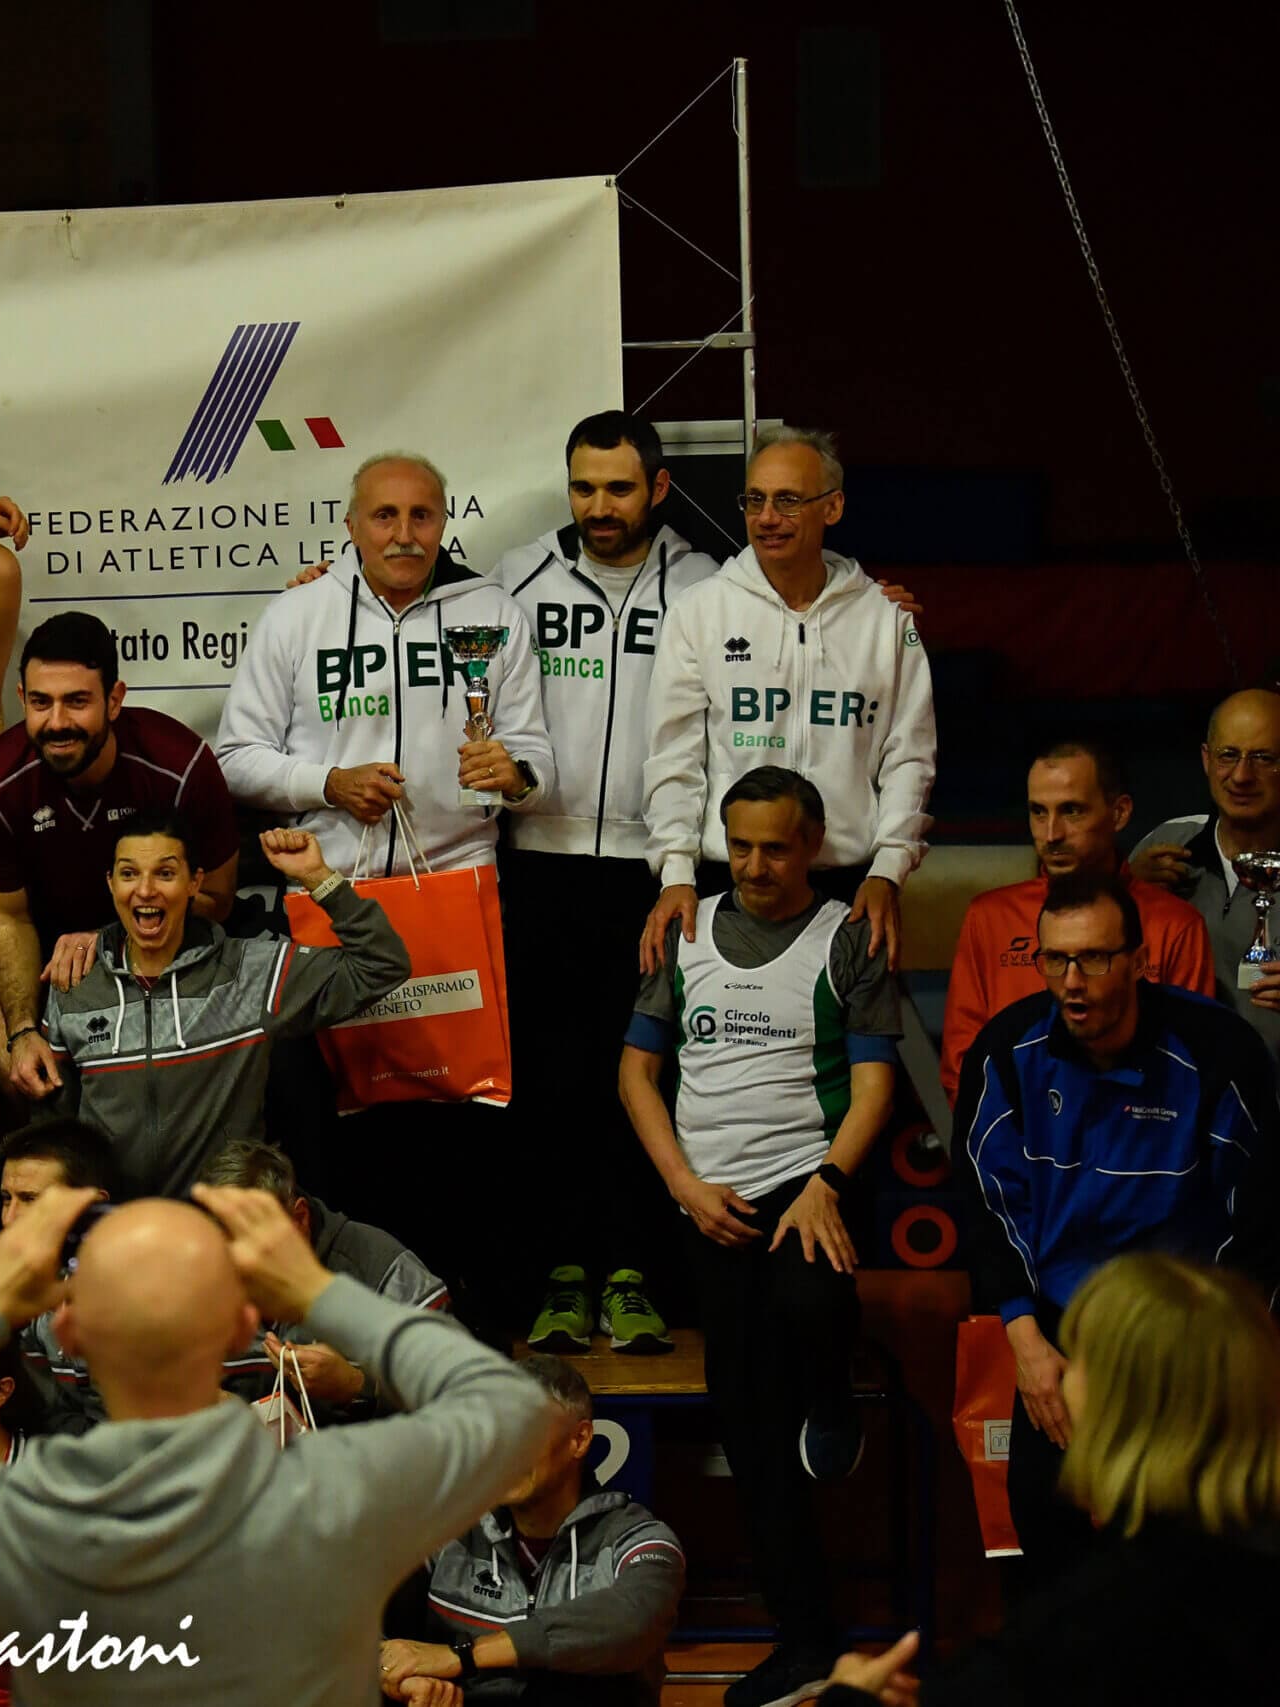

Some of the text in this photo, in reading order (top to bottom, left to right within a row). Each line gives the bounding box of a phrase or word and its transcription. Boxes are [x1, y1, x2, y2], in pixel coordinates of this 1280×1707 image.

[27, 503, 290, 536] FEDERAZIONE
[47, 551, 82, 575] DI
[99, 543, 279, 573] ATLETICA
[540, 650, 604, 679] Banca
[734, 732, 785, 748] Banca
[402, 978, 474, 999] RISPARMIO
[366, 999, 422, 1017] VENETO
[725, 1010, 770, 1023] Circolo
[724, 1022, 797, 1039] Dipendenti
